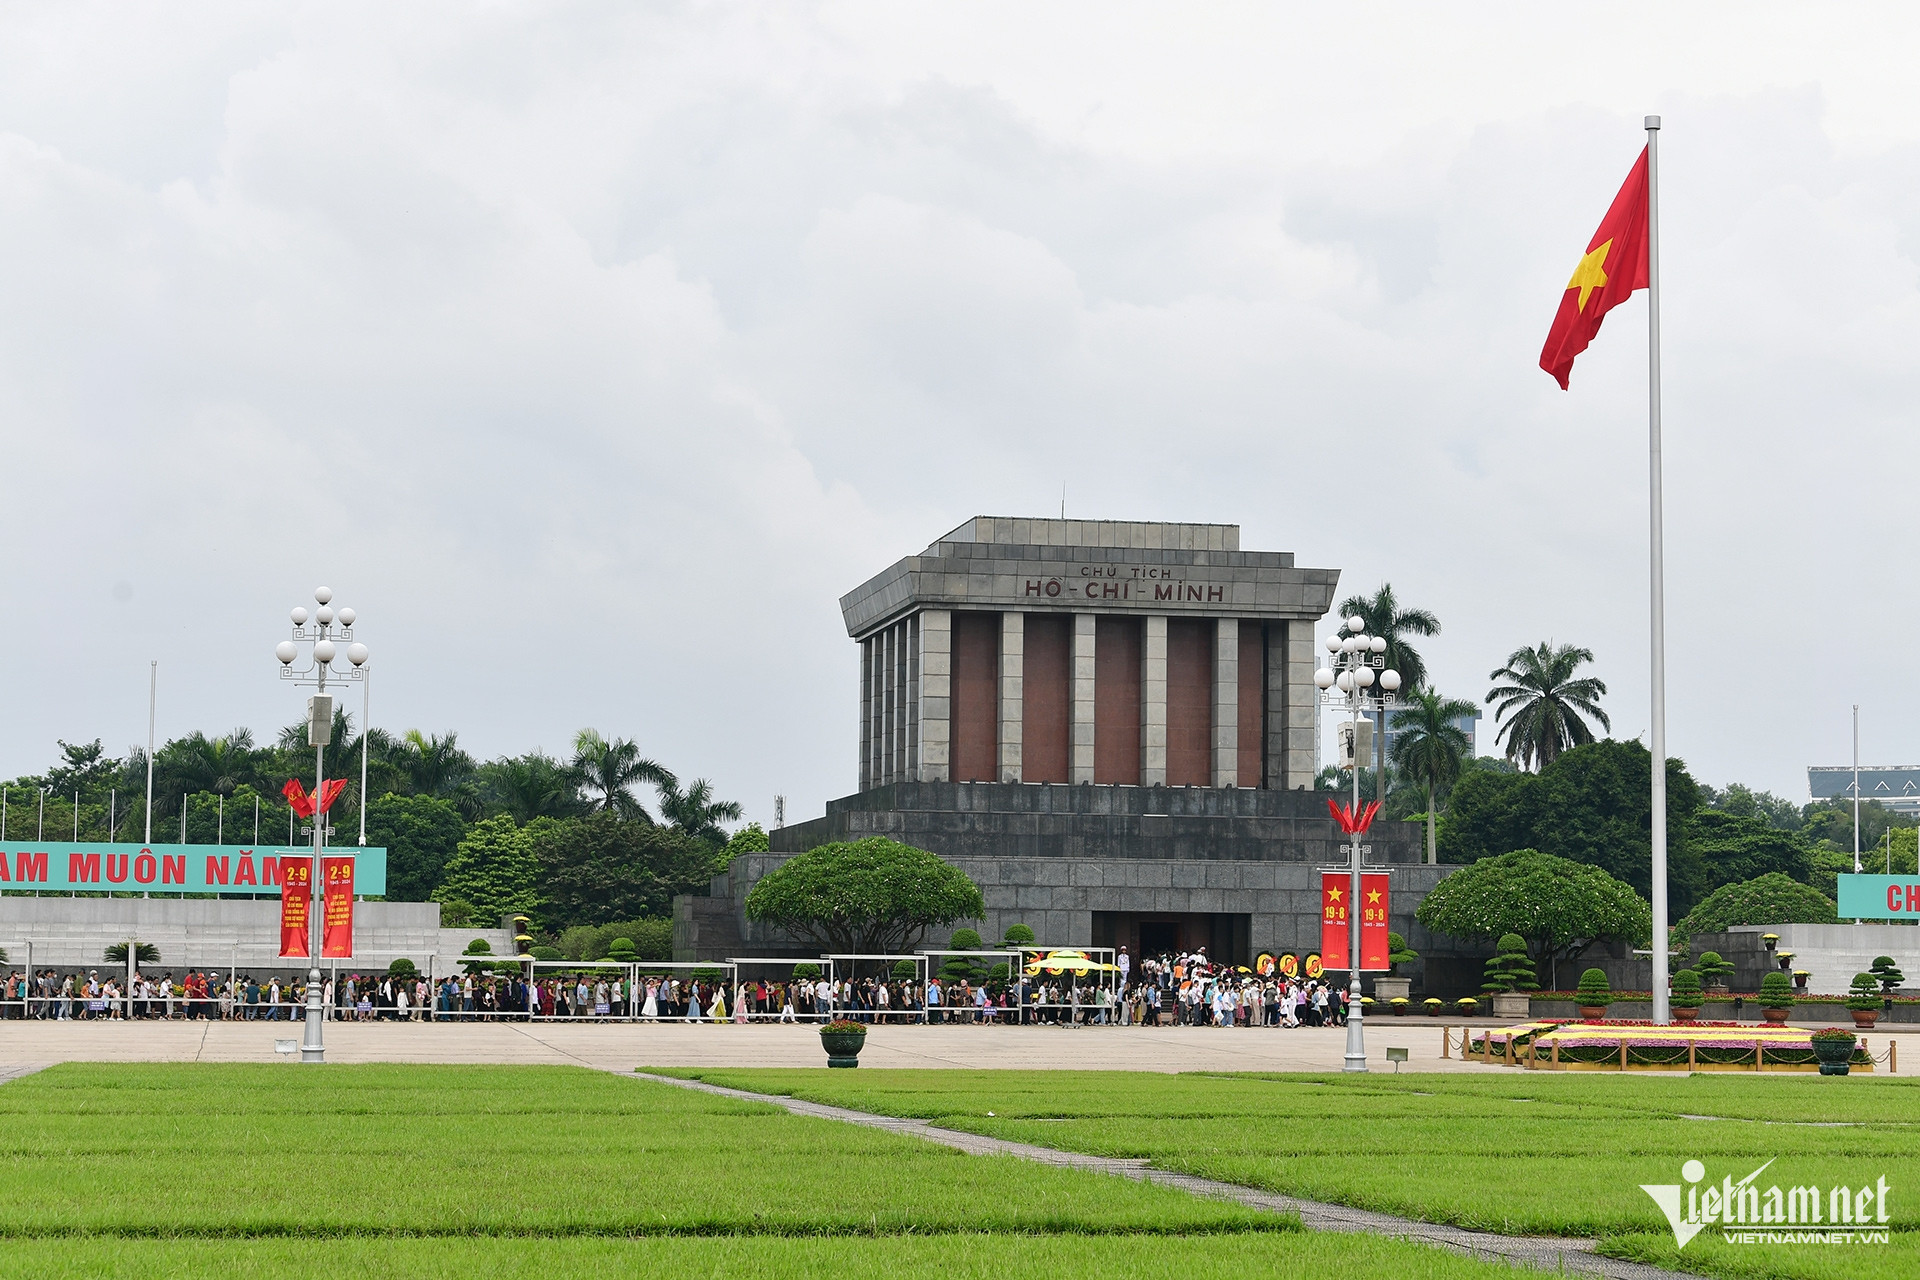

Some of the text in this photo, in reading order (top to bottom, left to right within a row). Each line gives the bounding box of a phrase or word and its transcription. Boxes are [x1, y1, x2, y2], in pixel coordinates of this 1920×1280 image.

[1081, 563, 1171, 582] CHỦ TỊCH
[68, 848, 186, 885] MUÔN
[287, 867, 308, 881] 2-9
[330, 865, 351, 880] 2-9
[1887, 884, 1920, 912] CH
[1325, 906, 1345, 919] 19-8
[1365, 908, 1384, 921] 19-8
